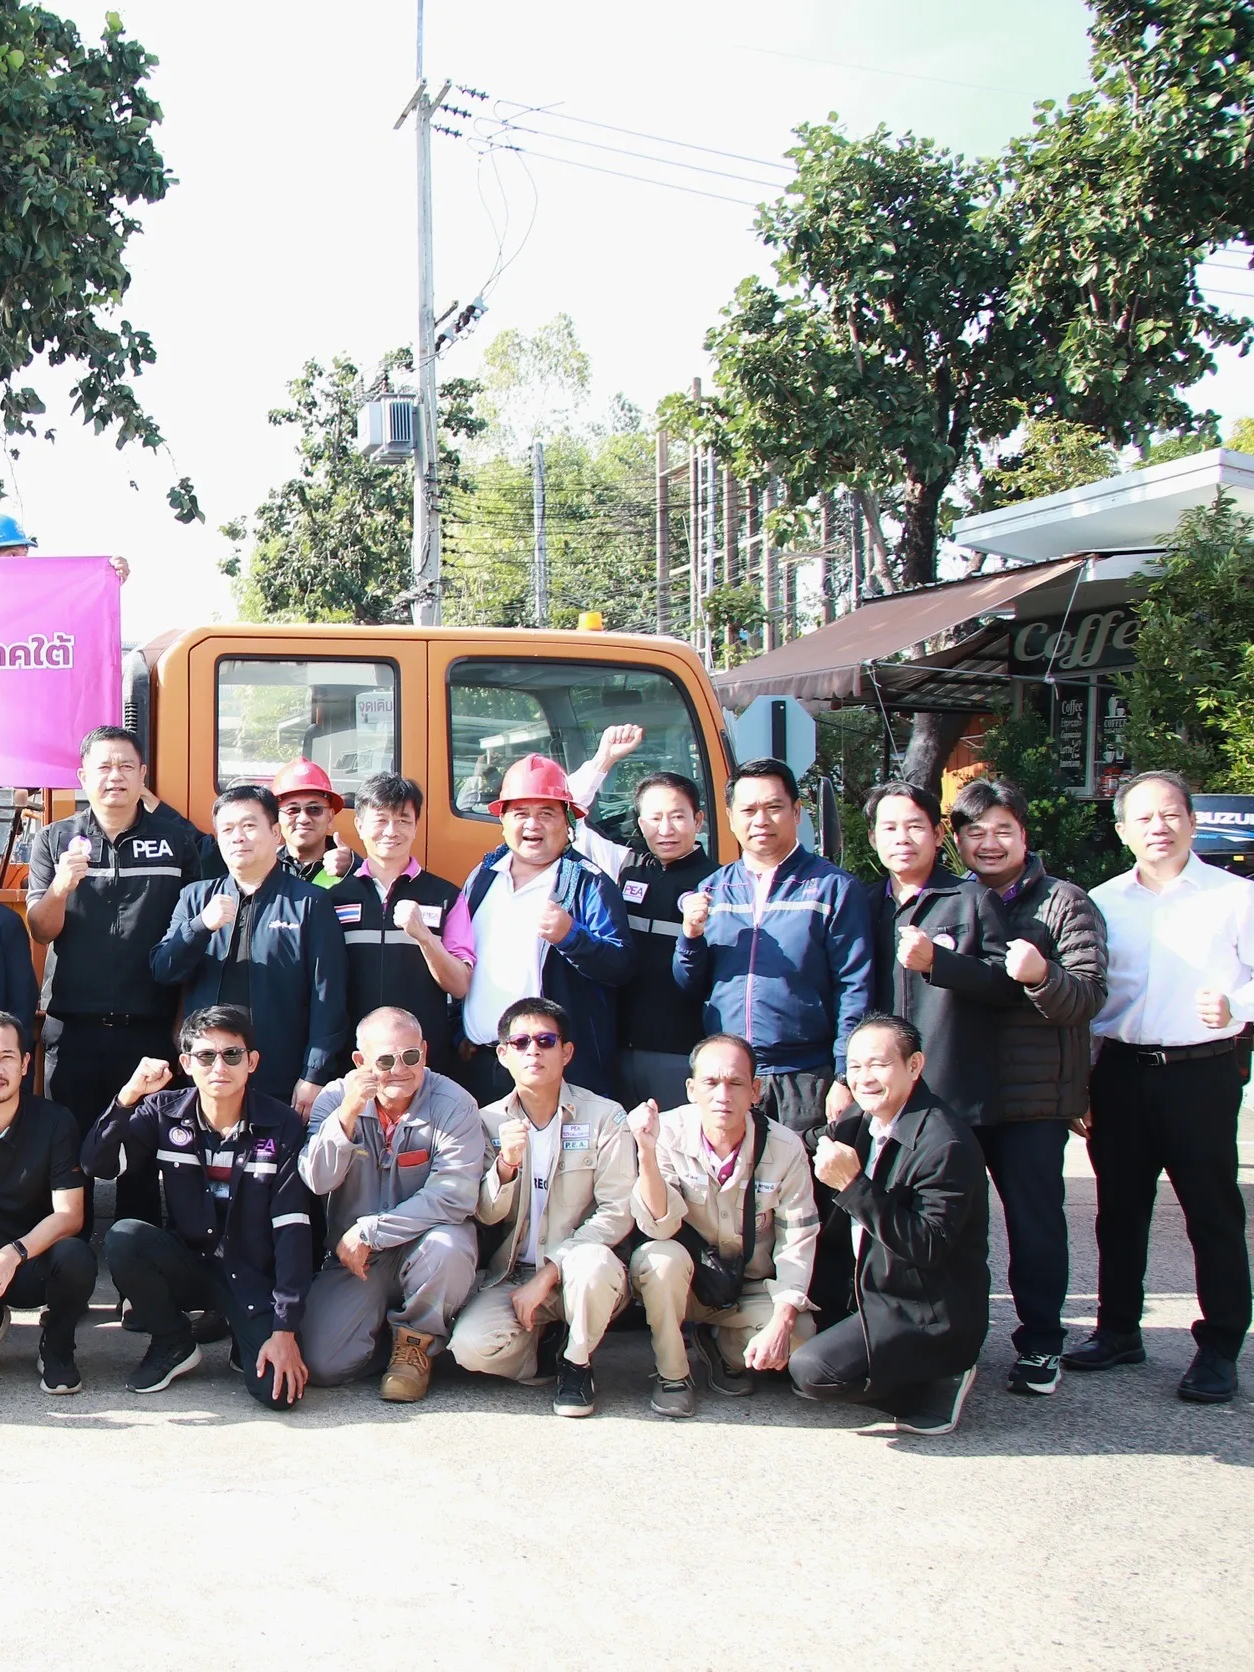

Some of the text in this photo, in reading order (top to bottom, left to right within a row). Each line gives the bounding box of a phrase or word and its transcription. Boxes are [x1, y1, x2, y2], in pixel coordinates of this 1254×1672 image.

[1013, 610, 1143, 669] Coffe
[1061, 699, 1082, 715] Coffee
[132, 839, 174, 858] PEA
[624, 885, 643, 897] PEA
[254, 1138, 276, 1152] EA
